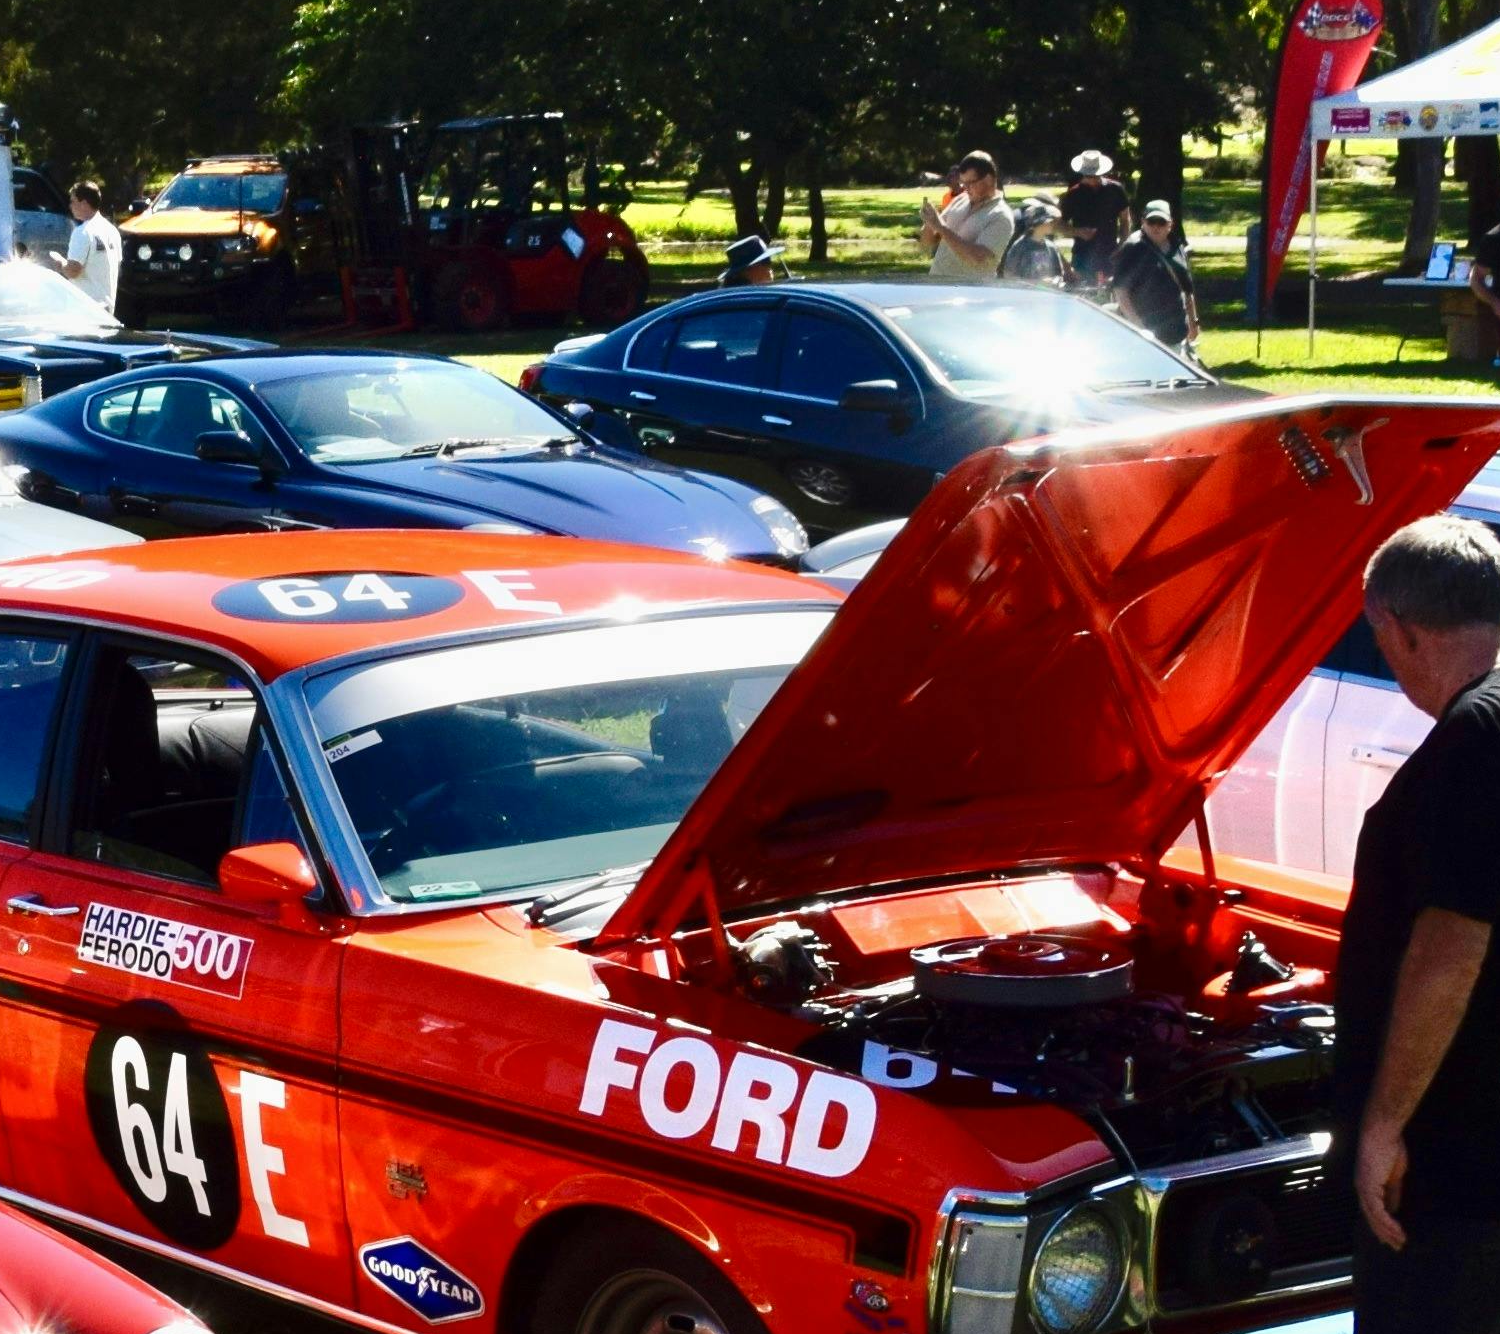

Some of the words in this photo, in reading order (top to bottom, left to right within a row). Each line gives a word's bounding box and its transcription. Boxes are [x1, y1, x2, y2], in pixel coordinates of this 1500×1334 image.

[257, 573, 412, 616] 64
[461, 569, 562, 615] E
[330, 745, 351, 759] 204
[85, 905, 176, 948] HARDIE-
[80, 932, 171, 977] FERODO
[173, 927, 241, 980] 500
[579, 1018, 878, 1178] FORD
[112, 1035, 212, 1217] 64
[240, 1070, 310, 1248] E
